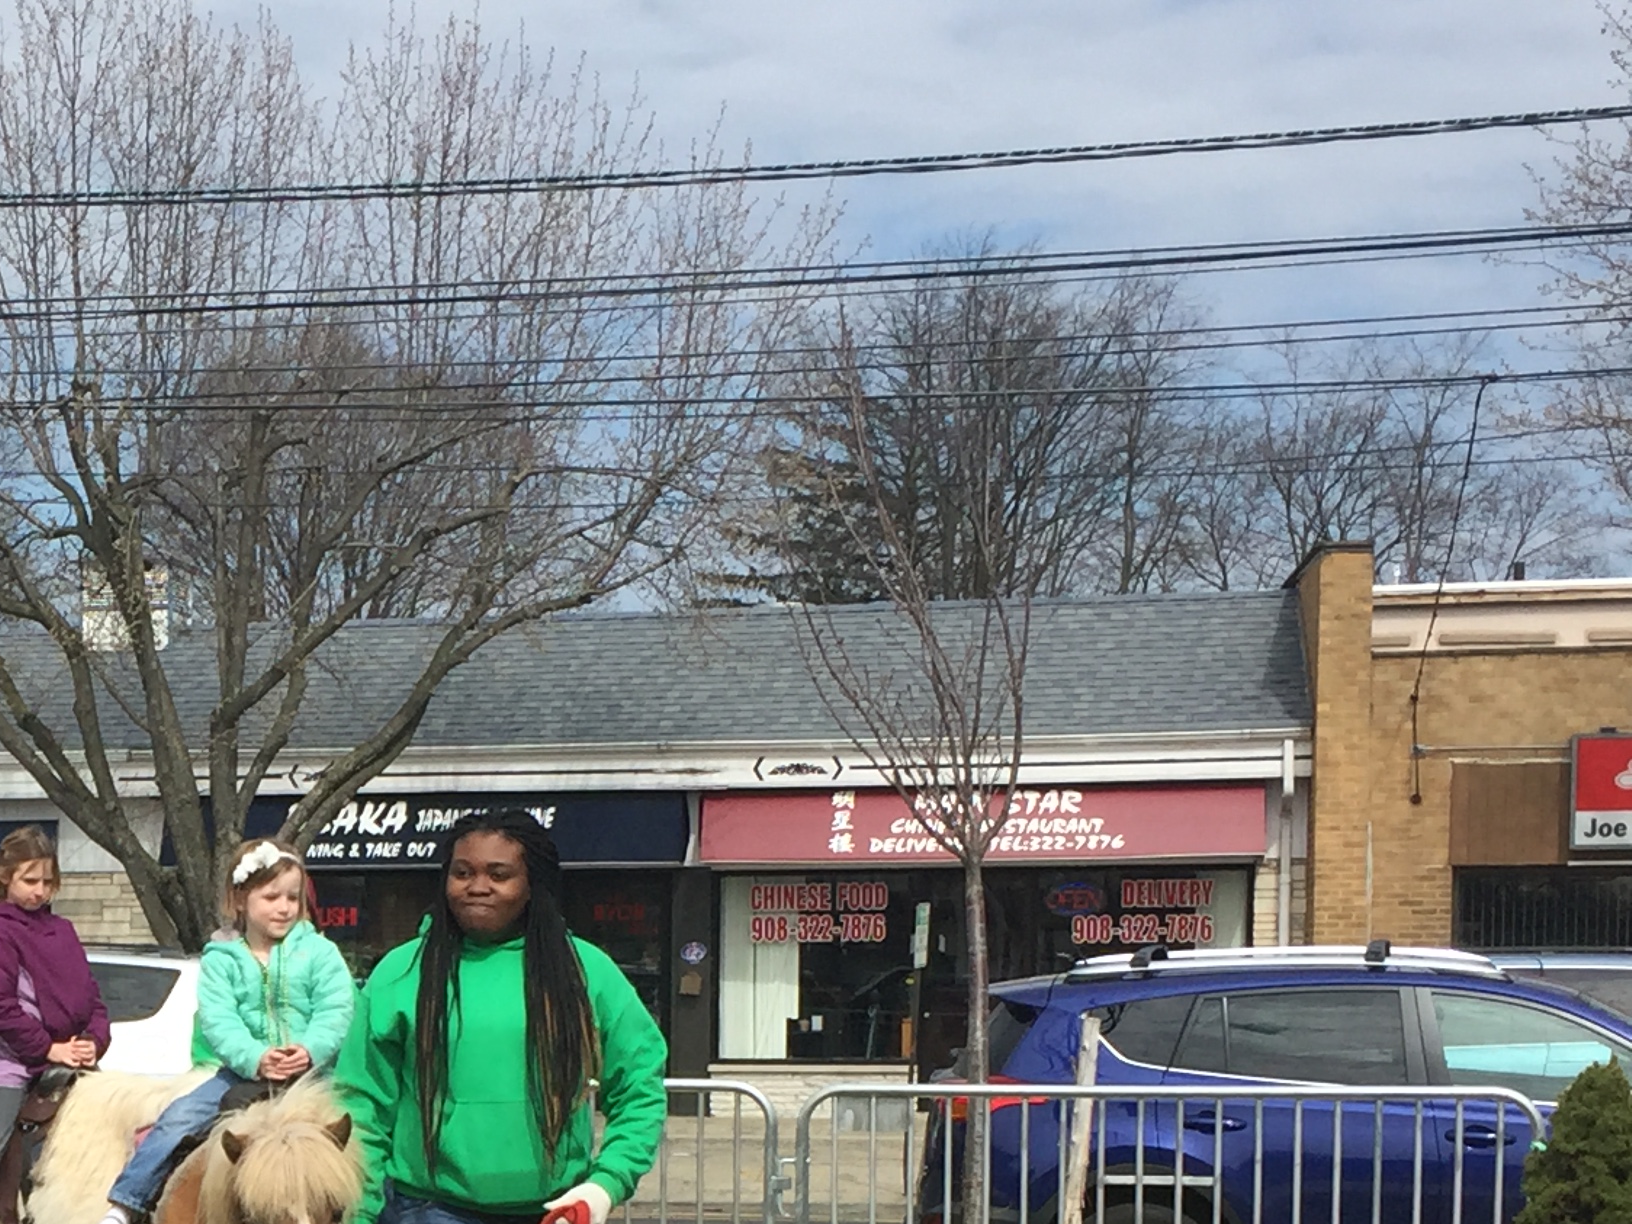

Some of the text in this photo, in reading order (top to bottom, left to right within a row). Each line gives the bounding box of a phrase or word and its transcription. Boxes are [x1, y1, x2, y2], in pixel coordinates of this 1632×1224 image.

[1008, 789, 1083, 815] STAR
[288, 801, 408, 836] AKA
[1584, 818, 1627, 838] Joe
[348, 842, 361, 858] &
[365, 842, 403, 859] TAKE
[406, 841, 437, 858] OUT
[751, 882, 889, 911] CHINESE FOOD
[1121, 879, 1214, 907] DELIVERY
[750, 913, 888, 943] 908-322-7876
[1072, 914, 1214, 944] 908-322-7876
